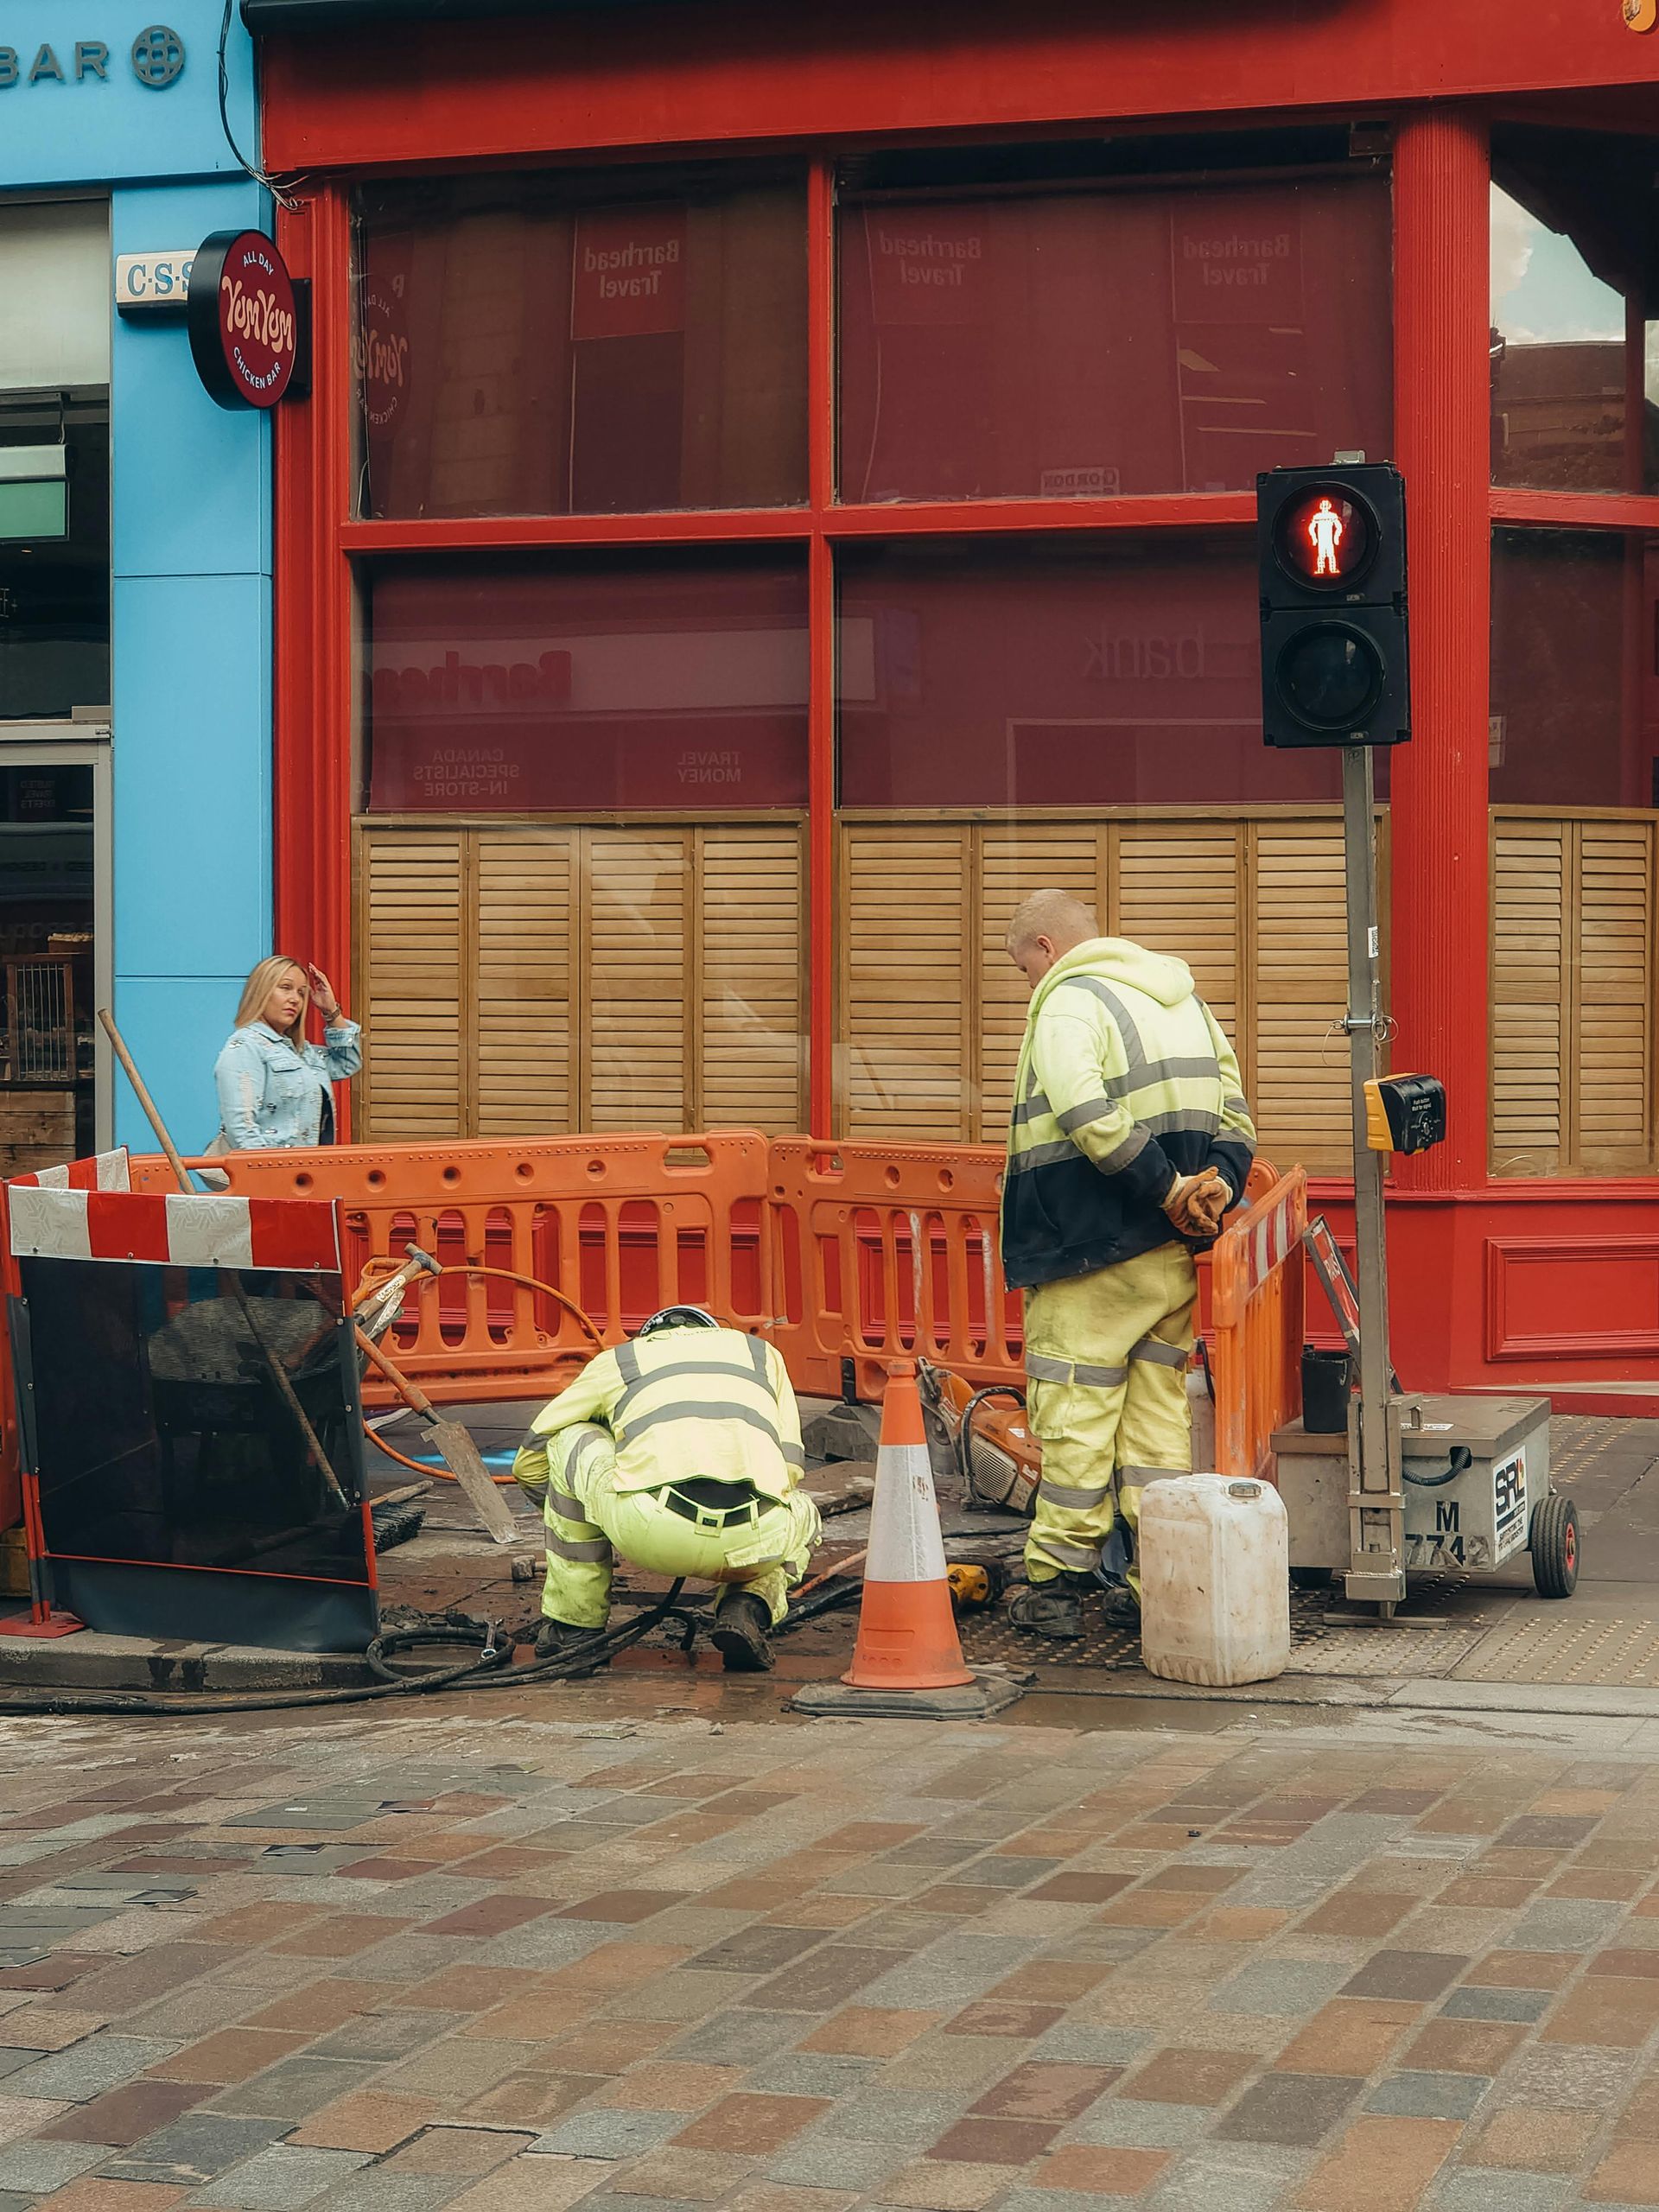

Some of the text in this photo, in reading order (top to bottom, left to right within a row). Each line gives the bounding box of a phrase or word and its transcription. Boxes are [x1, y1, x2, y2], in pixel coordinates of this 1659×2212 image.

[0, 41, 108, 84] BAR
[243, 251, 274, 276] ALL DAY
[233, 346, 281, 390] CHICKEN BAR
[1496, 1458, 1525, 1516] SRL
[1436, 1501, 1459, 1532] M
